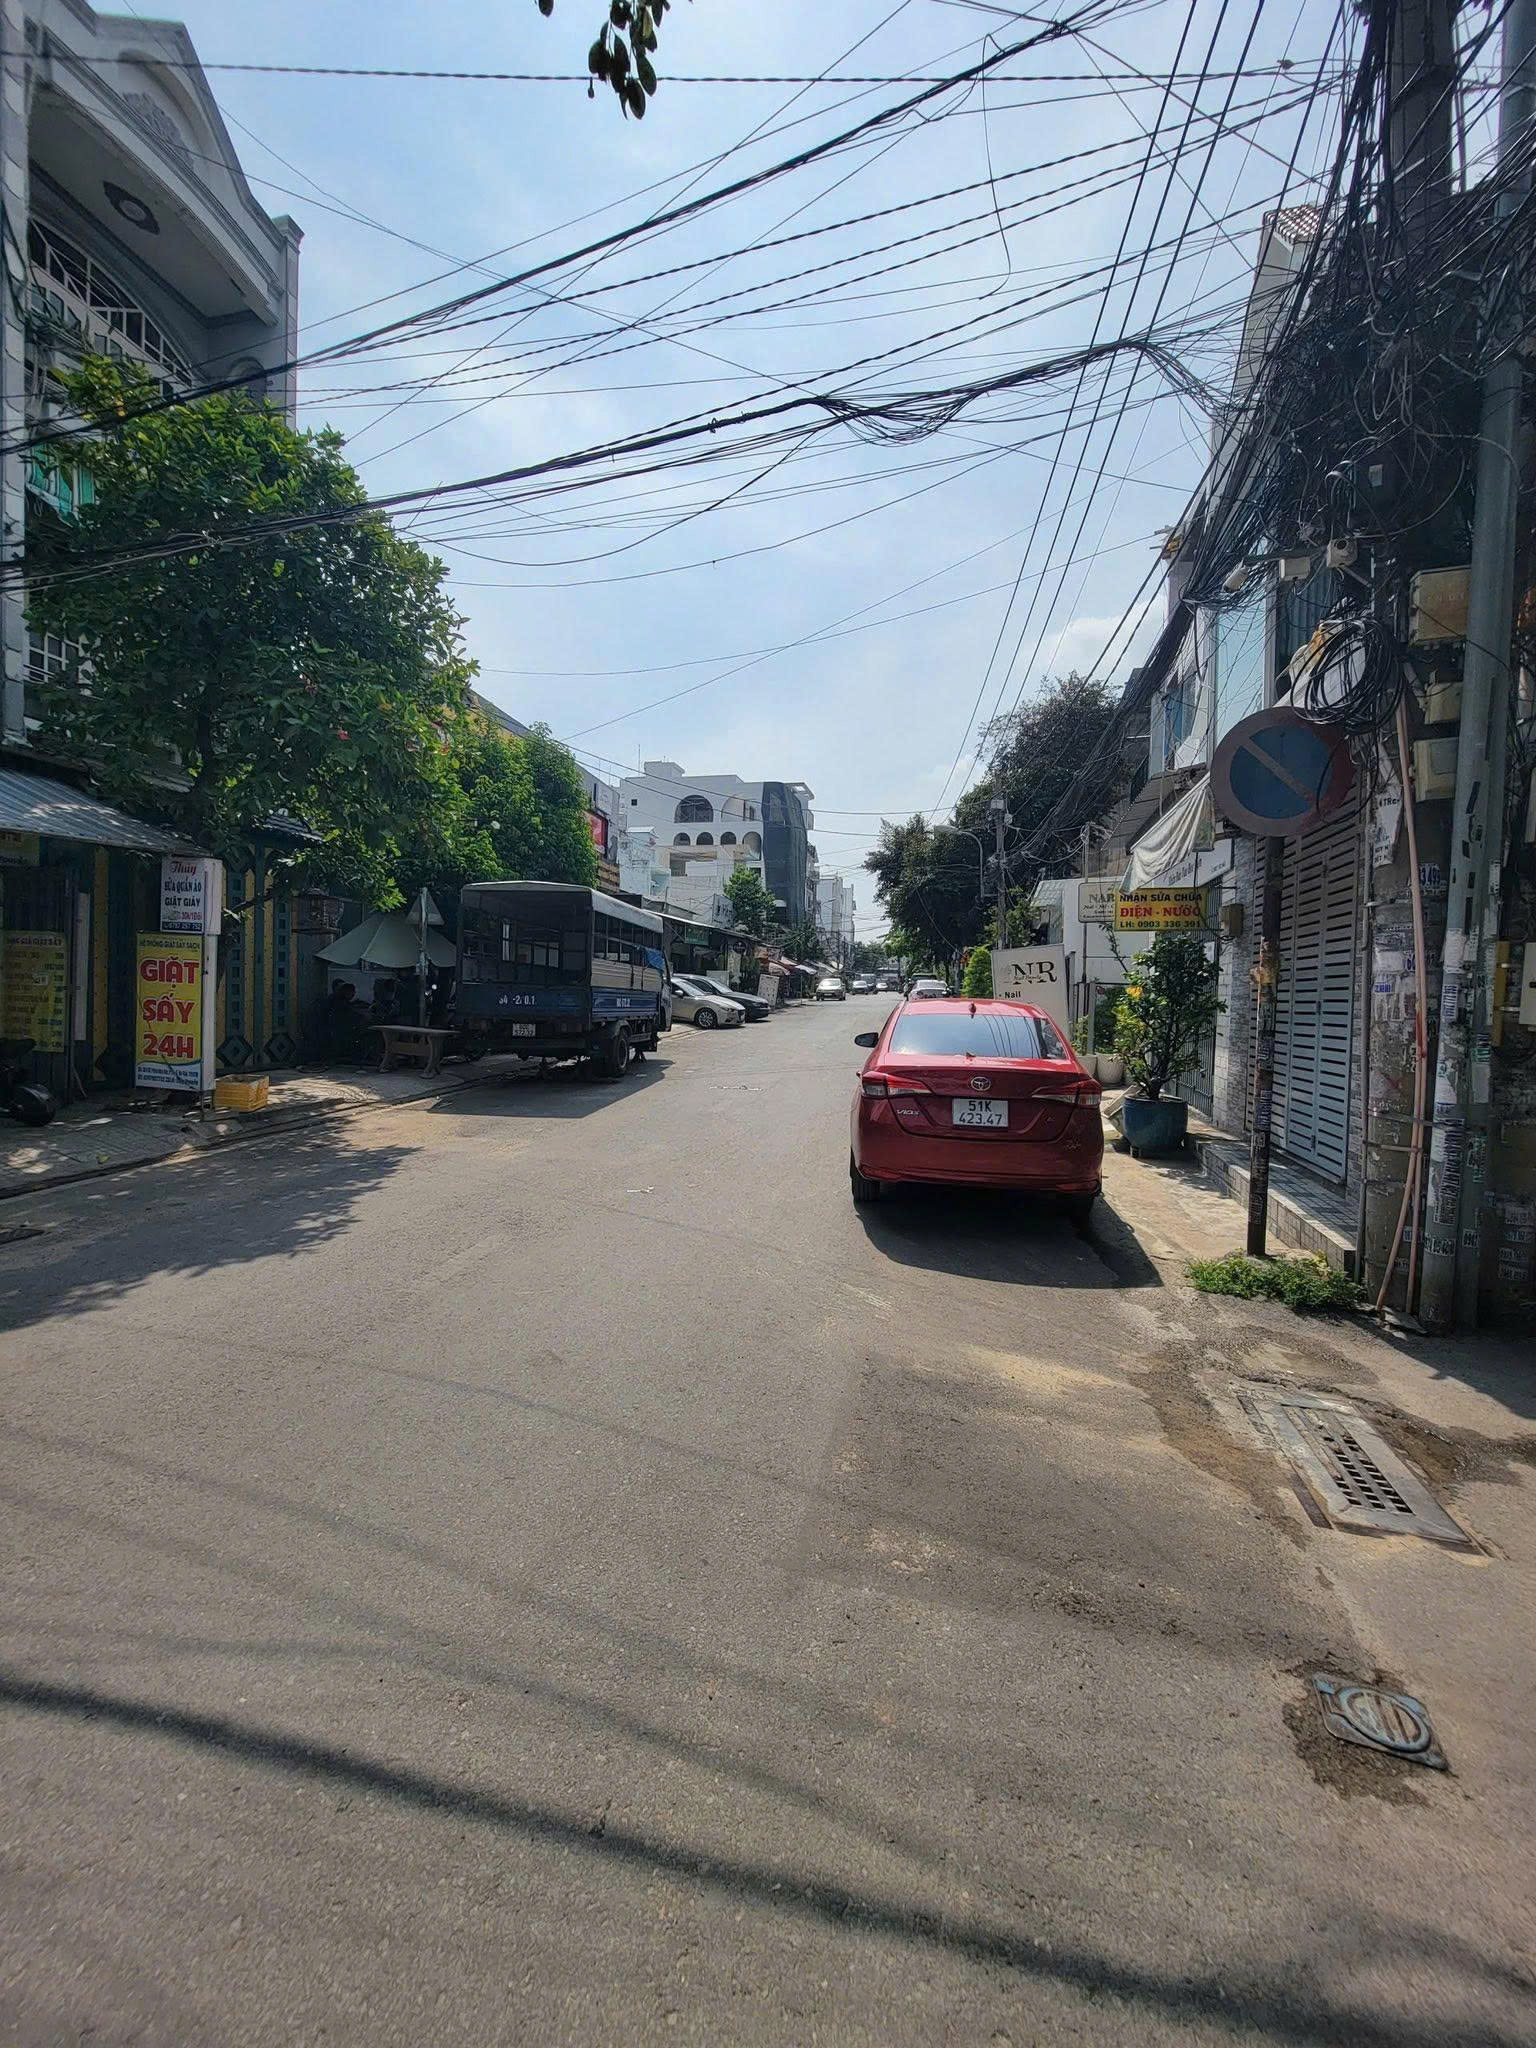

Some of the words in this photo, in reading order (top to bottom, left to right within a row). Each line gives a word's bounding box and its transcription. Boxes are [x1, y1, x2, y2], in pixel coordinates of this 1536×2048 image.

[1150, 890, 1170, 901] SỬA
[1120, 903, 1153, 919] ĐIỆN
[140, 955, 200, 988] GIẶT
[1011, 961, 1057, 985] NR
[1004, 990, 1021, 999] Nail
[143, 992, 196, 1024] SẤY
[143, 1032, 194, 1058] 24H
[968, 1100, 993, 1112] 51K
[958, 1113, 1003, 1125] 423.47
